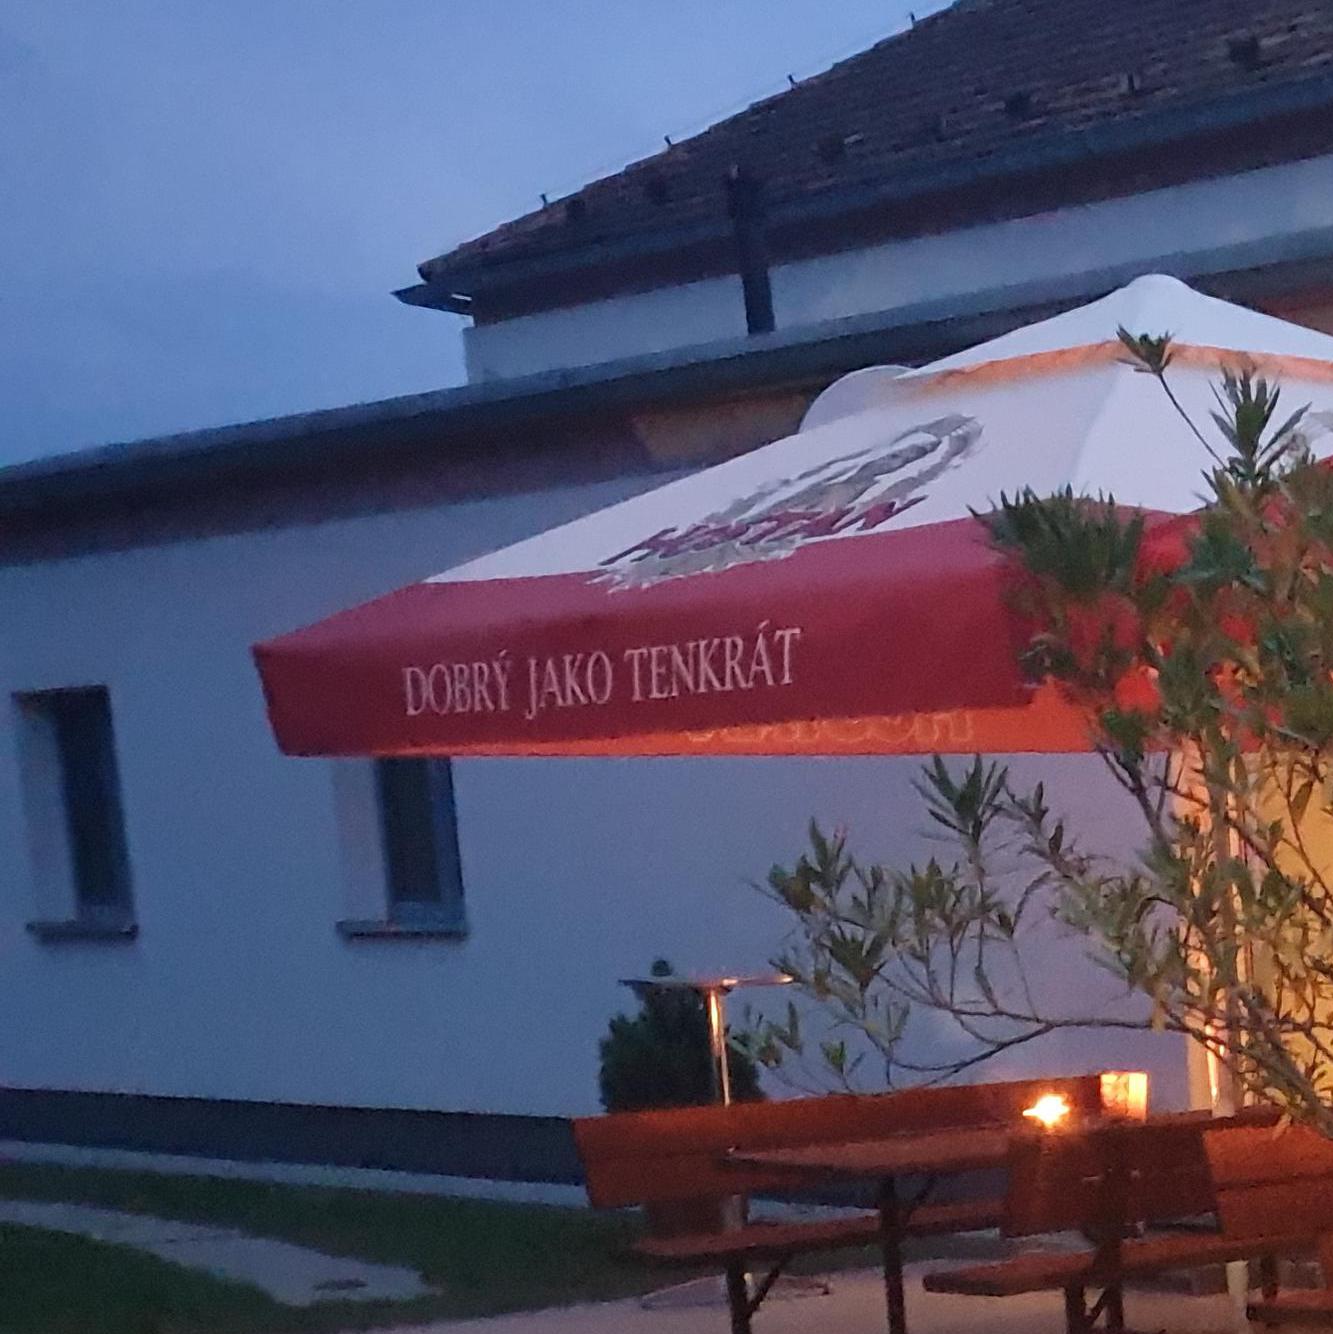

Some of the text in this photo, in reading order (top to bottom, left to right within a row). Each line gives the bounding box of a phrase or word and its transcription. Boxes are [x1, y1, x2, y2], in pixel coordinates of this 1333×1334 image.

[403, 620, 803, 720] DOBRÝ JAKO TENKRÁT
